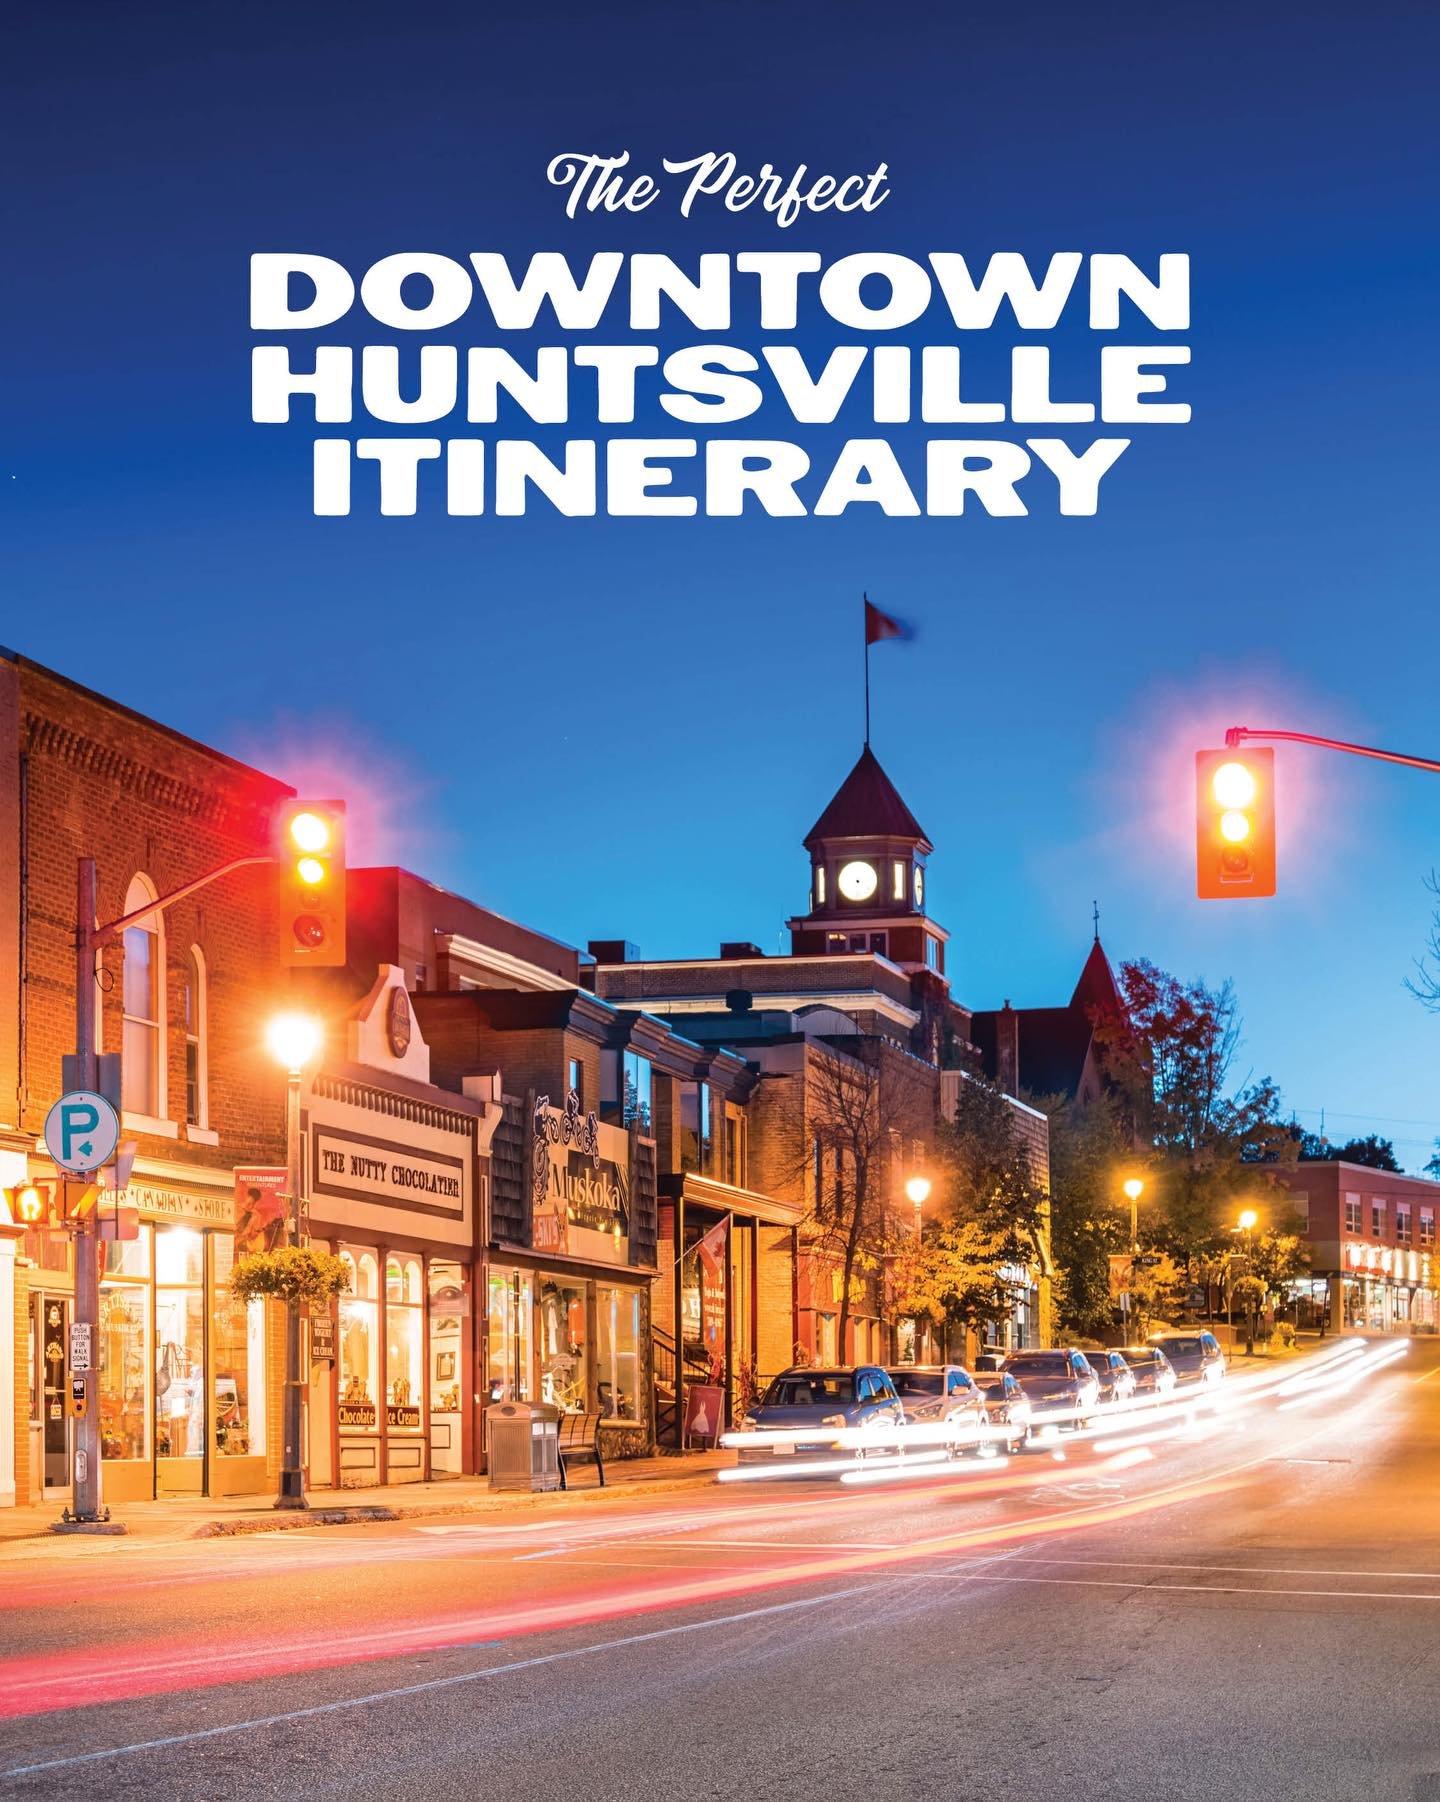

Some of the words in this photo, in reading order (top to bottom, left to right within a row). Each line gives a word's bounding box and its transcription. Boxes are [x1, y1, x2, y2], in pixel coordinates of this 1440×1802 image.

[61, 1103, 99, 1160] P
[239, 1174, 285, 1183] ENTERTAINMENT
[322, 1149, 345, 1173] THE
[351, 1155, 387, 1182] NUTTY
[391, 1165, 459, 1198] CHOCOLATIER
[552, 1164, 621, 1212] Muskoka
[135, 1187, 184, 1212] CANADIAN
[199, 1200, 226, 1219] STORE
[339, 1406, 375, 1425] Chocolate
[397, 1408, 420, 1426] Cream
